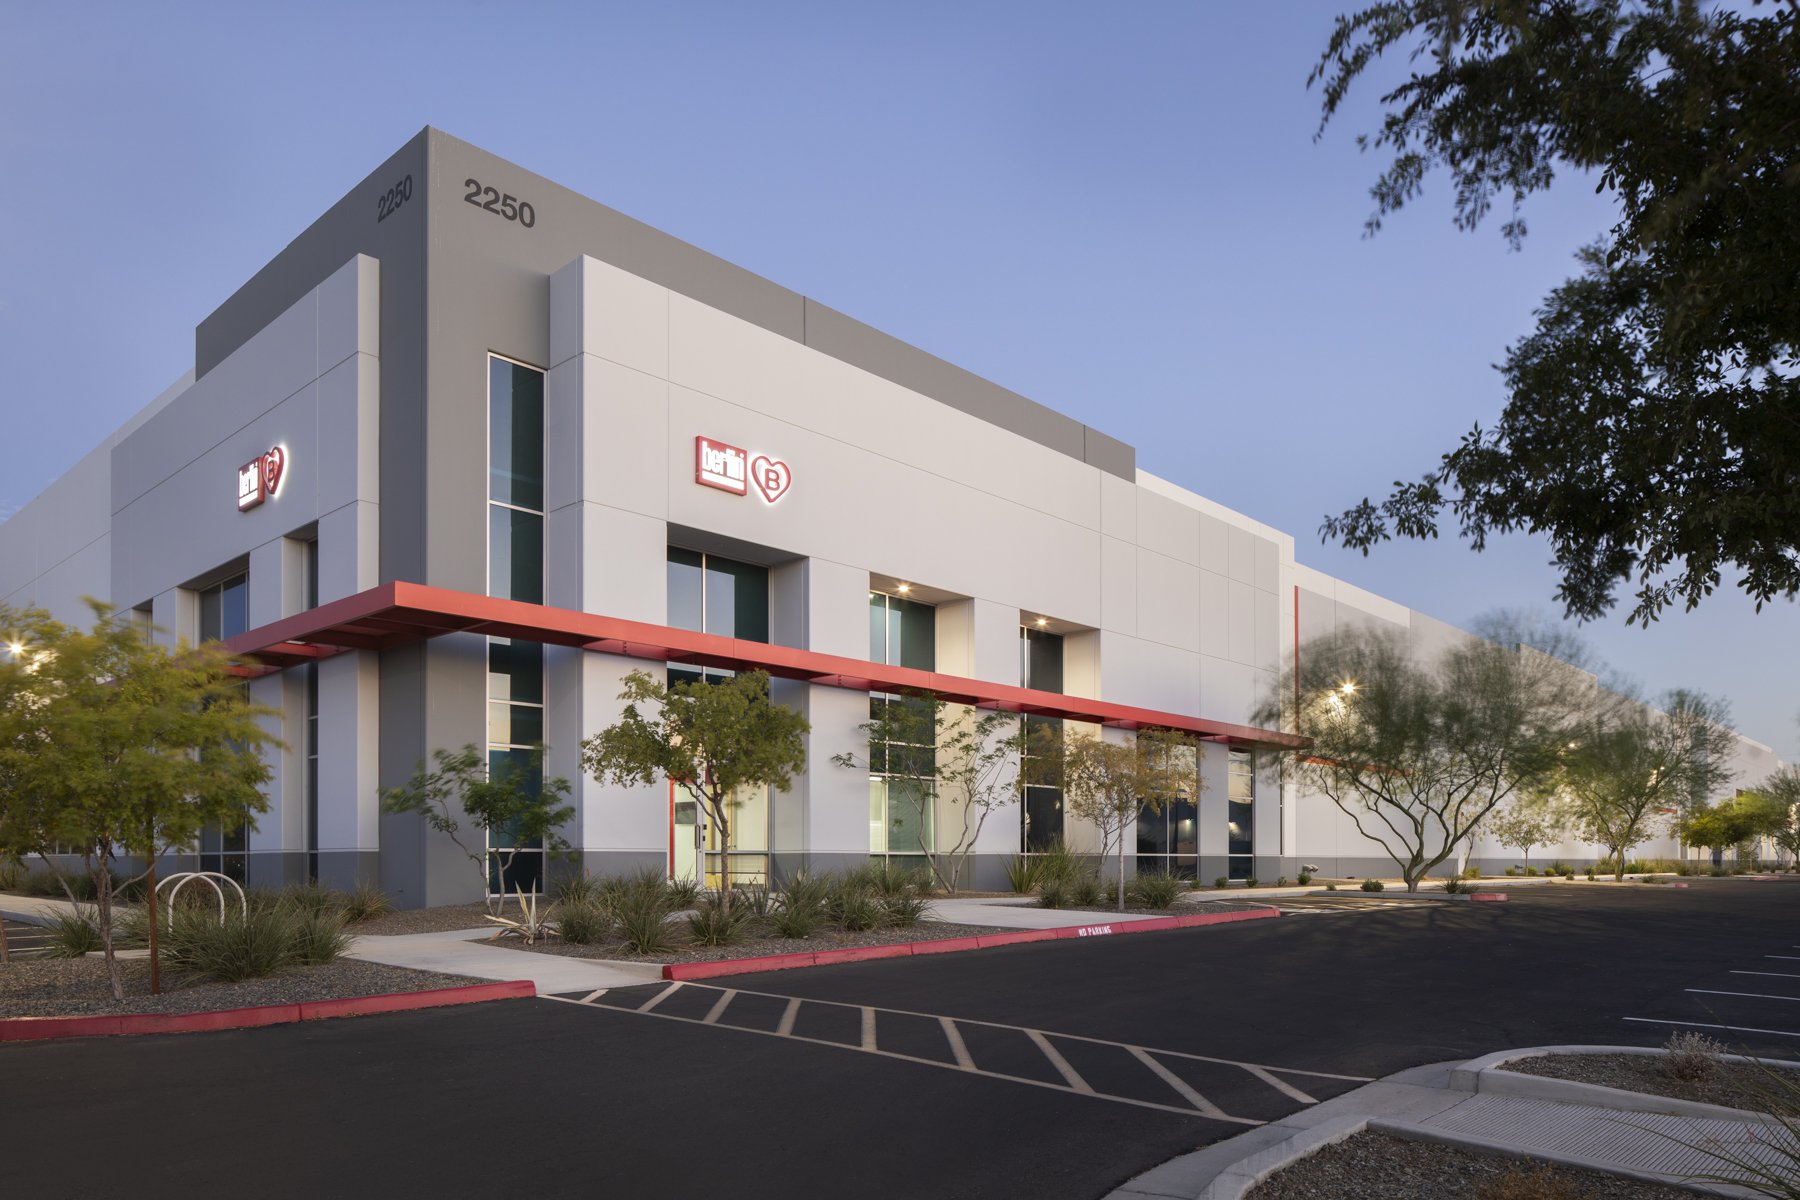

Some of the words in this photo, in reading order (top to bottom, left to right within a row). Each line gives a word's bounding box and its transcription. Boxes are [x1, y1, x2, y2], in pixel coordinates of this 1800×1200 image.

[377, 174, 413, 224] 2250
[463, 178, 536, 229] 2250
[764, 468, 780, 491] B
[1078, 928, 1087, 937] NO
[1087, 925, 1112, 936] PARKING
